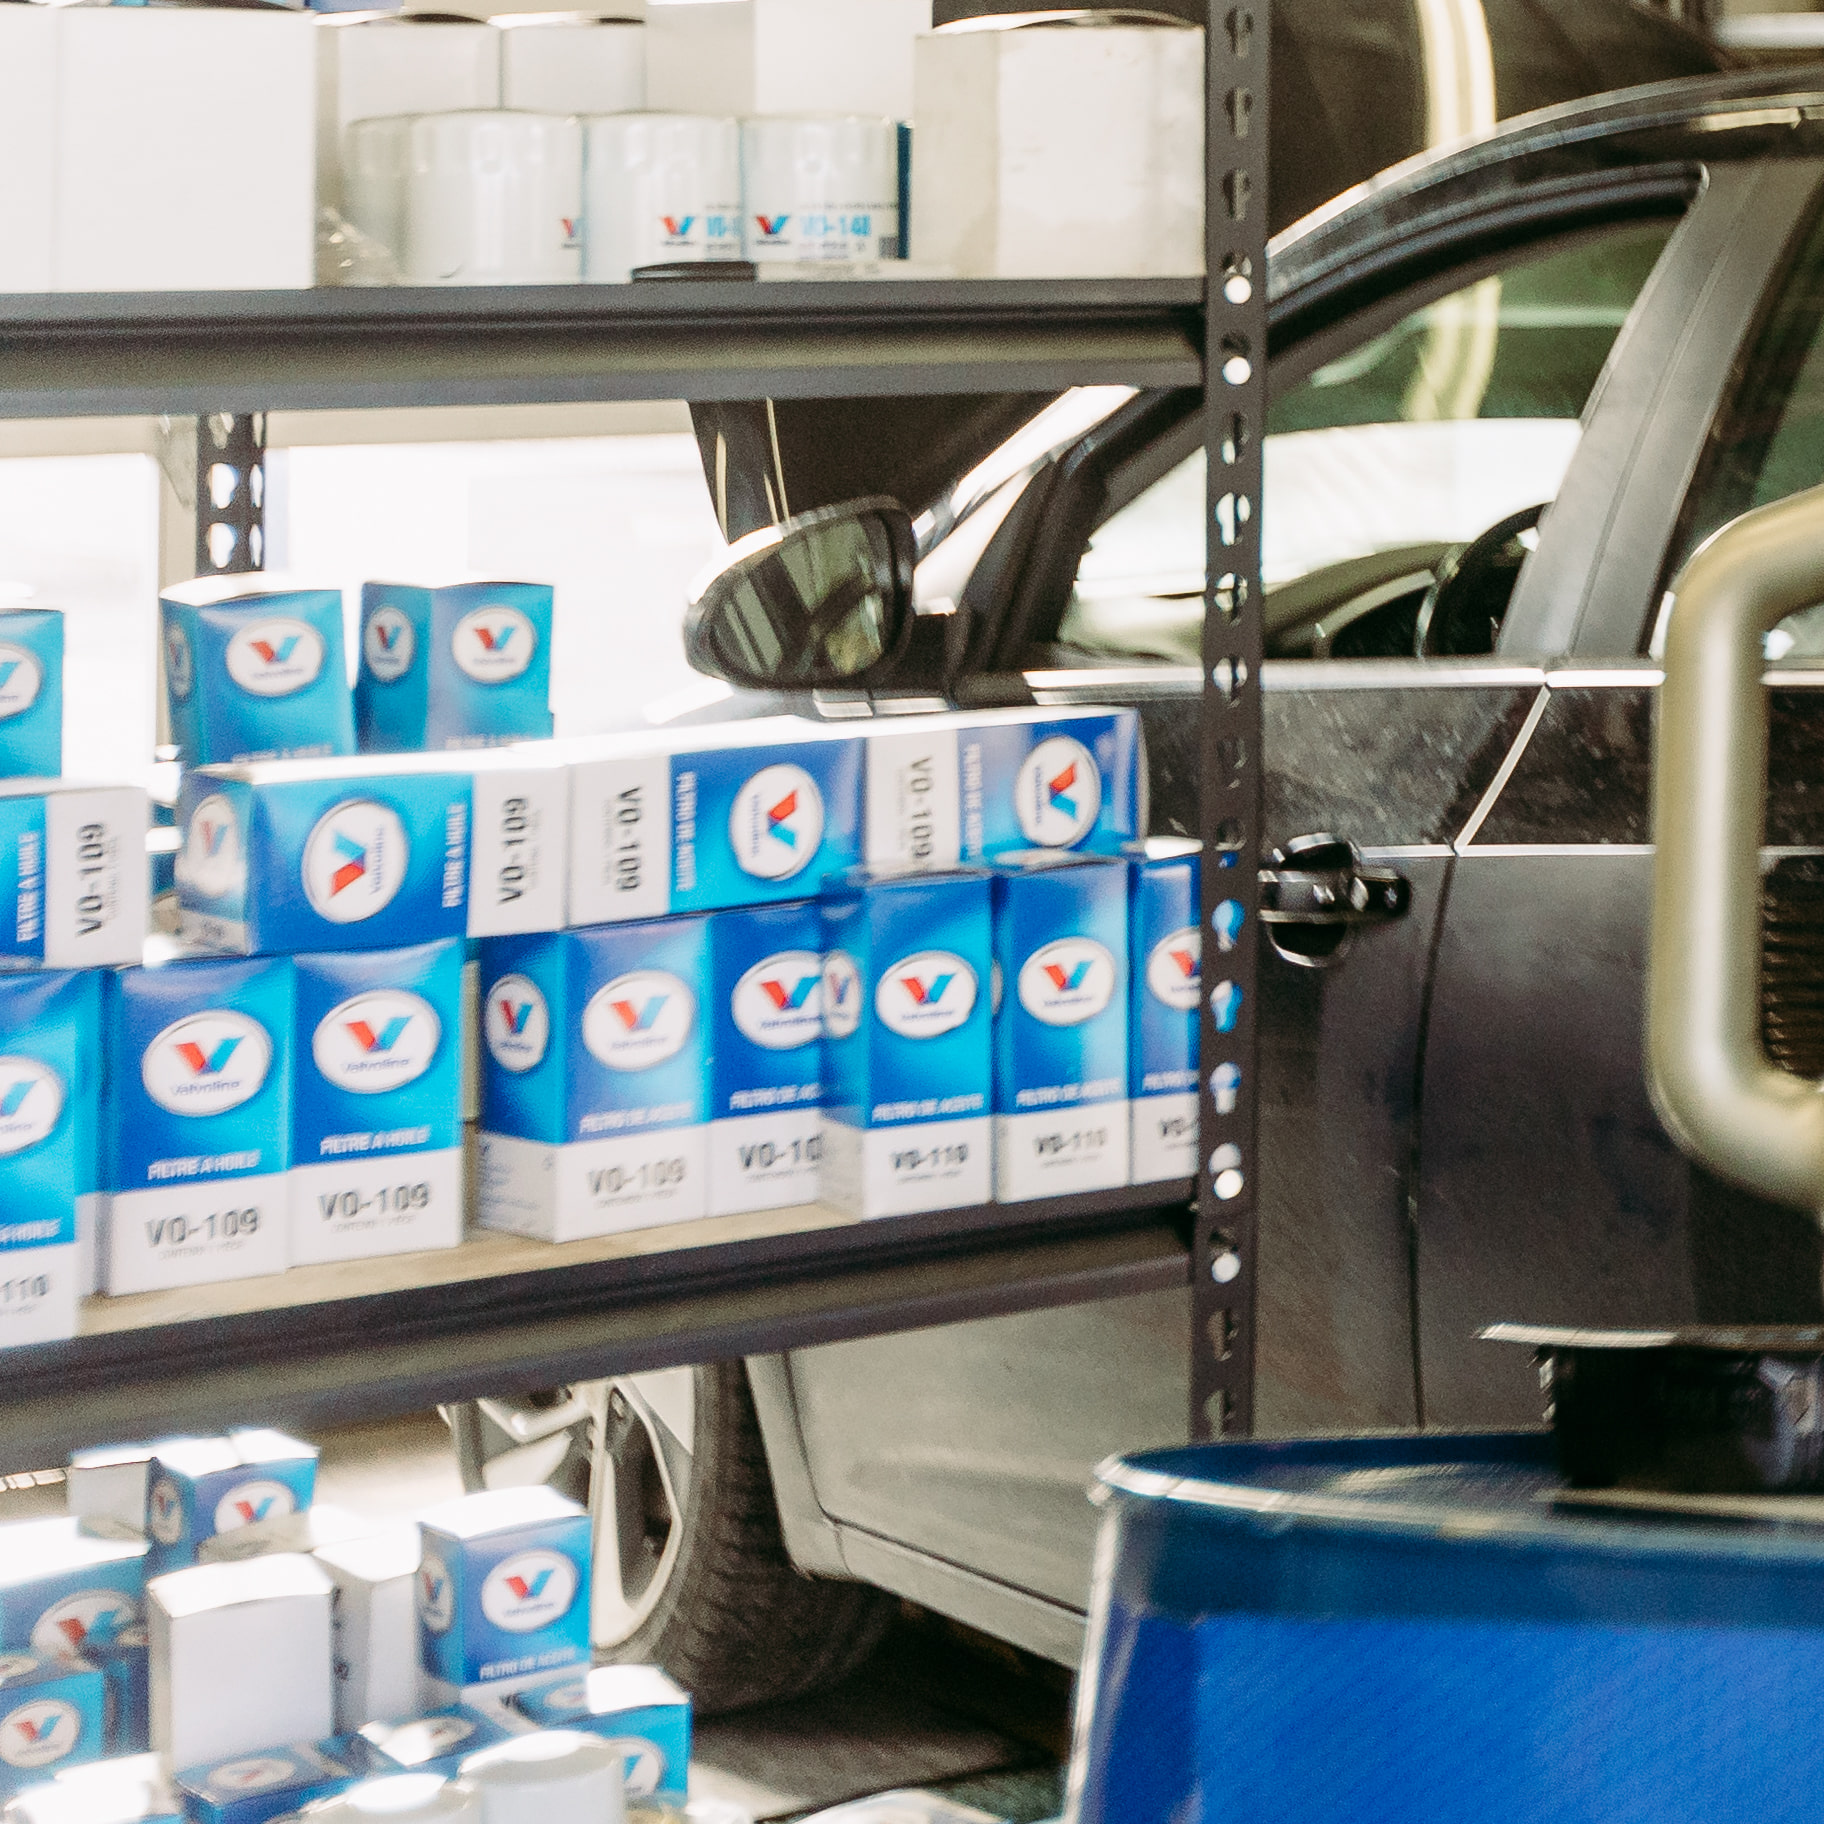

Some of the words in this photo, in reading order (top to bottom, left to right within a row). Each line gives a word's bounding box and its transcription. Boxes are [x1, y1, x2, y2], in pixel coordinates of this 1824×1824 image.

[911, 755, 934, 860] VO-109
[18, 831, 40, 877] HUILE
[496, 796, 529, 906] VO-109
[615, 786, 643, 893] VO-109
[75, 822, 105, 936] VO-109
[442, 861, 467, 909] FILTRE
[16, 891, 39, 943] FILTRE
[320, 1130, 370, 1155] FILTRE
[738, 1133, 823, 1172] VO-10
[147, 1155, 198, 1180] FILTRE
[586, 1155, 687, 1197] VO-109
[318, 1182, 431, 1222] VO-109
[145, 1207, 261, 1249] VO-109
